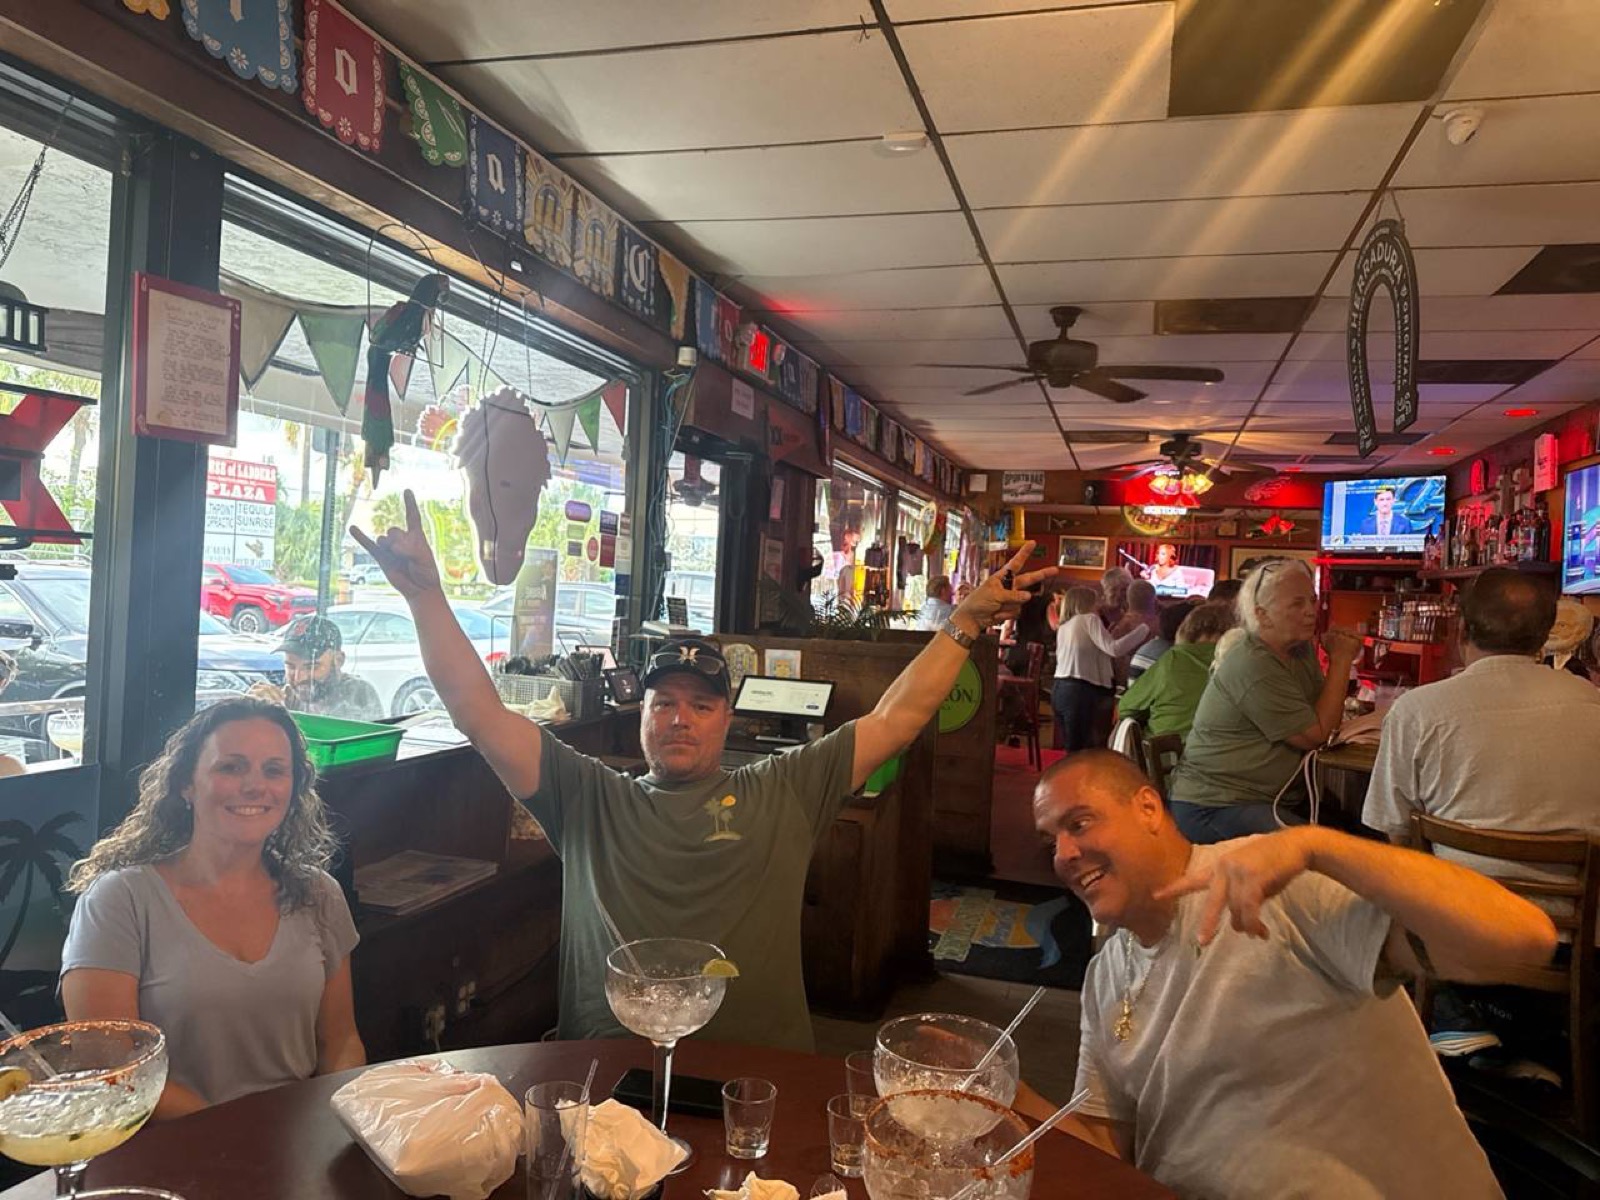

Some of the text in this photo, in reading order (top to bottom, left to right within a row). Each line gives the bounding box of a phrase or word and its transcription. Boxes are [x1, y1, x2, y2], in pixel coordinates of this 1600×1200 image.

[206, 480, 266, 501] PLAZA
[238, 503, 275, 516] TEQUILA
[236, 515, 275, 529] SUNRISE
